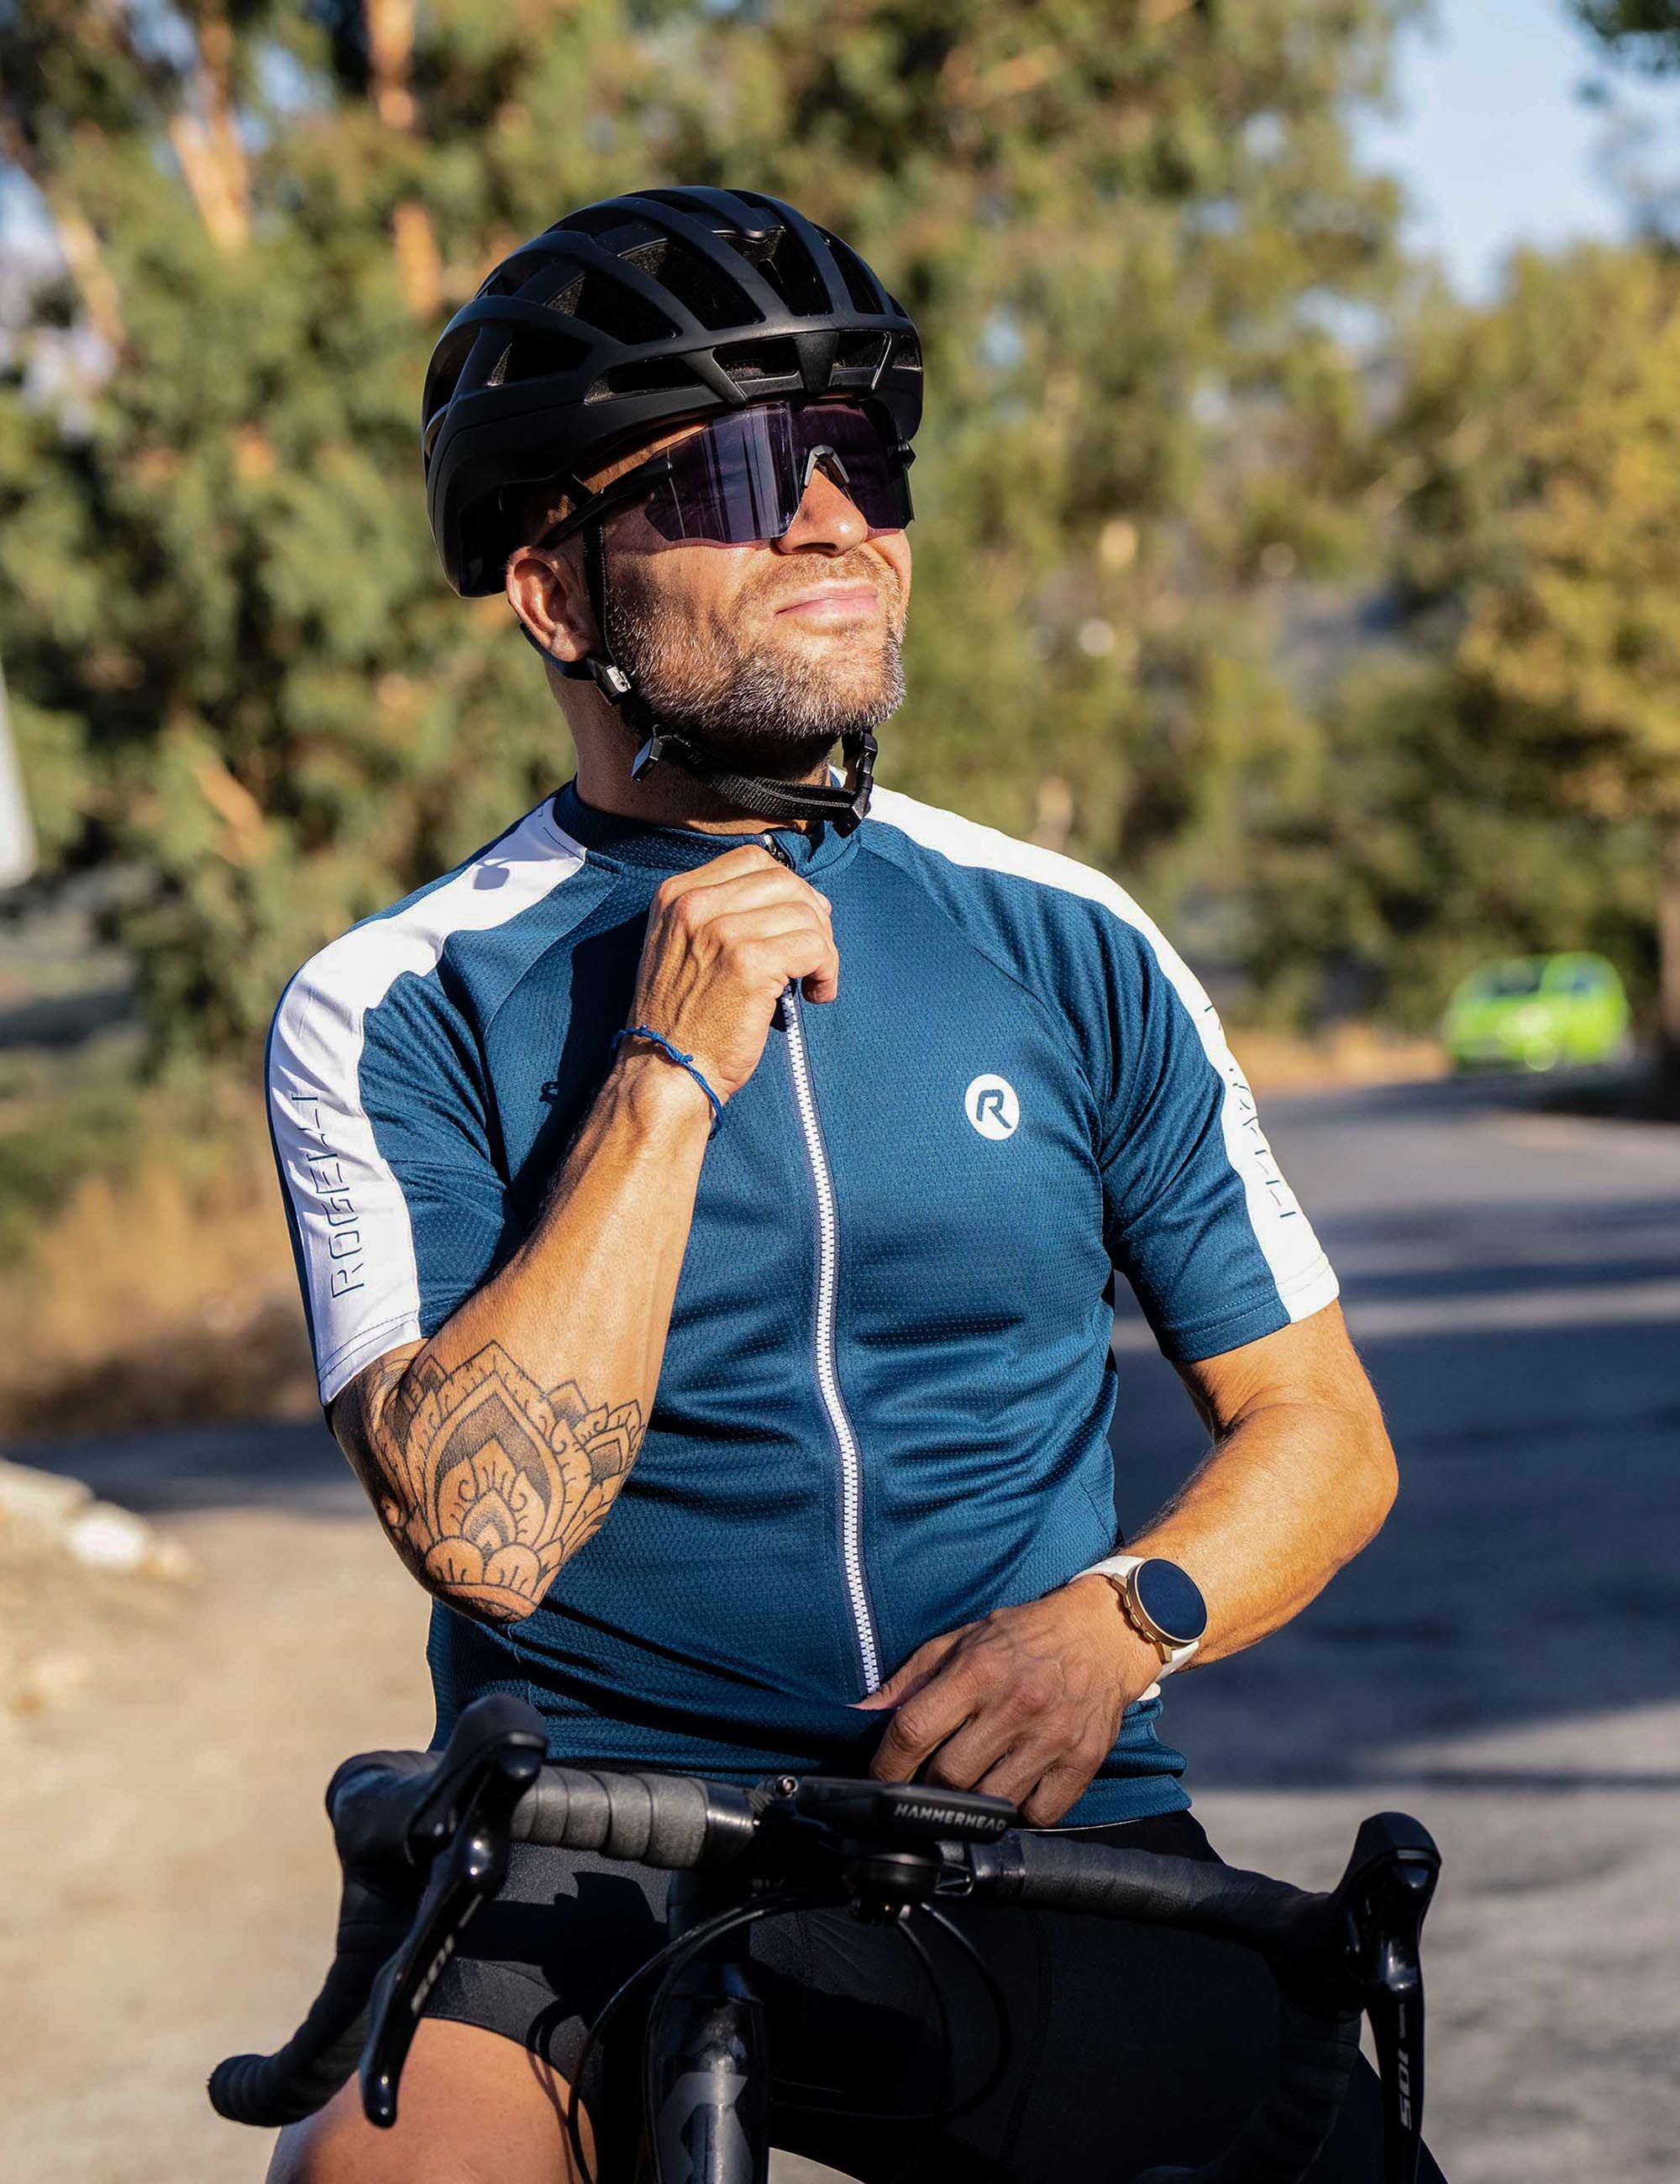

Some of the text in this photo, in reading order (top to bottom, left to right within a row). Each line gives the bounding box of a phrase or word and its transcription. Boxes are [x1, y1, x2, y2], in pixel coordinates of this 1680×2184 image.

[976, 1089, 1012, 1129] R
[894, 1803, 1006, 1831] HAMMERHEAD
[1398, 2049, 1411, 2130] 105
